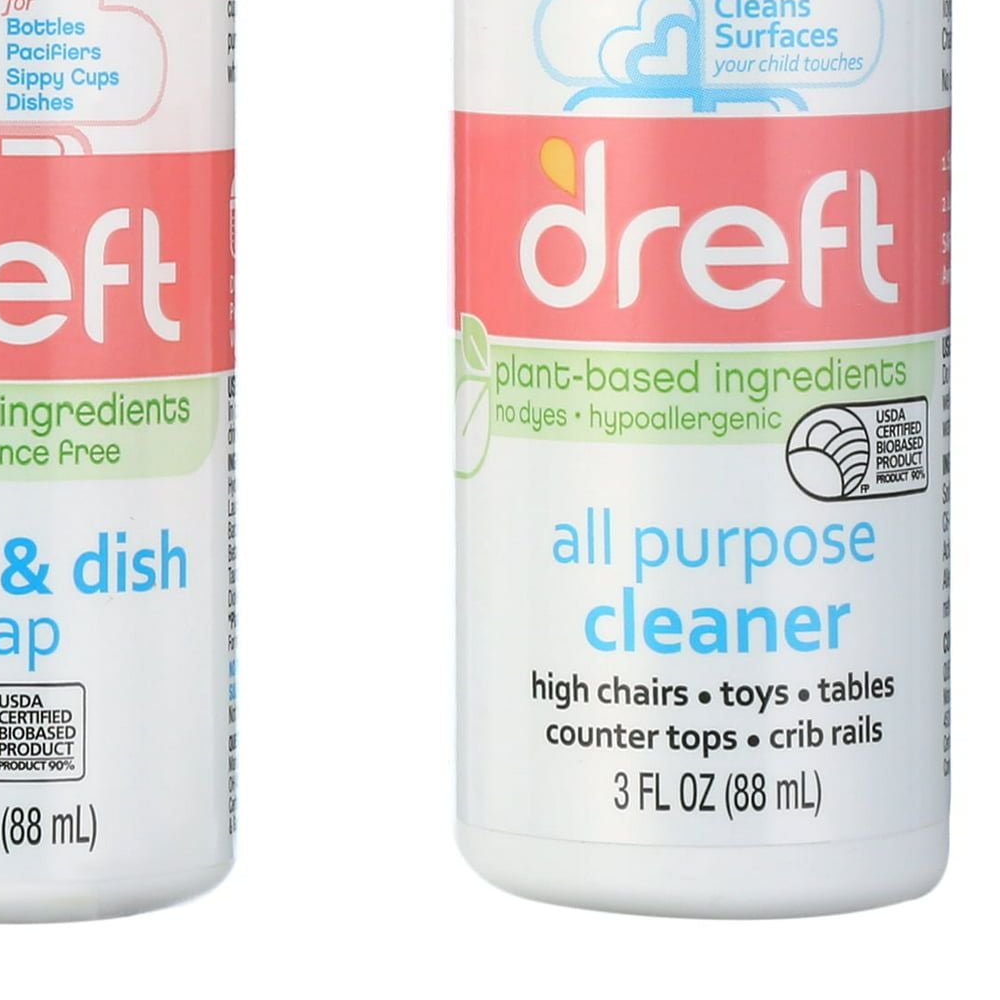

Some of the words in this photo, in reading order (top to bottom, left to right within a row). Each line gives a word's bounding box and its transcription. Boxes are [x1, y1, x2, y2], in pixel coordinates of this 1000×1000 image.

[6, 18, 85, 36] Bottles
[715, 22, 838, 50] Surfaces
[6, 44, 101, 61] Pacifiers
[713, 58, 756, 77] your
[759, 54, 799, 73] child
[803, 54, 863, 72] touches
[6, 69, 65, 90] Sippy
[71, 69, 119, 90] Cups
[6, 94, 74, 111] Dishes
[520, 139, 899, 310] dreft
[495, 355, 699, 394] plant-based
[715, 358, 907, 402] ingredients
[0, 392, 191, 437] ingredients
[495, 403, 516, 423] no
[519, 402, 567, 432] dyes
[590, 404, 782, 437] hypoallergenic
[876, 408, 906, 423] USDA
[876, 421, 921, 438] CERTIFIED
[59, 439, 121, 464] free
[876, 436, 924, 454] BIOBASED
[876, 452, 922, 470] PRODUCT
[876, 472, 908, 484] PRODUCT
[911, 470, 925, 480] 90%
[553, 507, 611, 565] all
[636, 521, 876, 584] purpose
[0, 537, 53, 595] &
[73, 528, 187, 593] dish
[585, 587, 851, 654] cleaner
[532, 670, 589, 711] high
[597, 677, 689, 706] chairs
[720, 682, 789, 714] toys
[818, 672, 894, 703] tables
[546, 720, 659, 749] counter
[666, 725, 737, 757] tops
[769, 719, 824, 748] crib
[832, 715, 882, 746] rails
[48, 761, 75, 770] 90%
[614, 772, 629, 809] 3
[639, 772, 670, 811] FL
[679, 773, 716, 812] OZ
[724, 772, 766, 820] (88
[776, 770, 822, 817] mL)
[0, 805, 41, 853] (88
[52, 803, 97, 851] mL)
